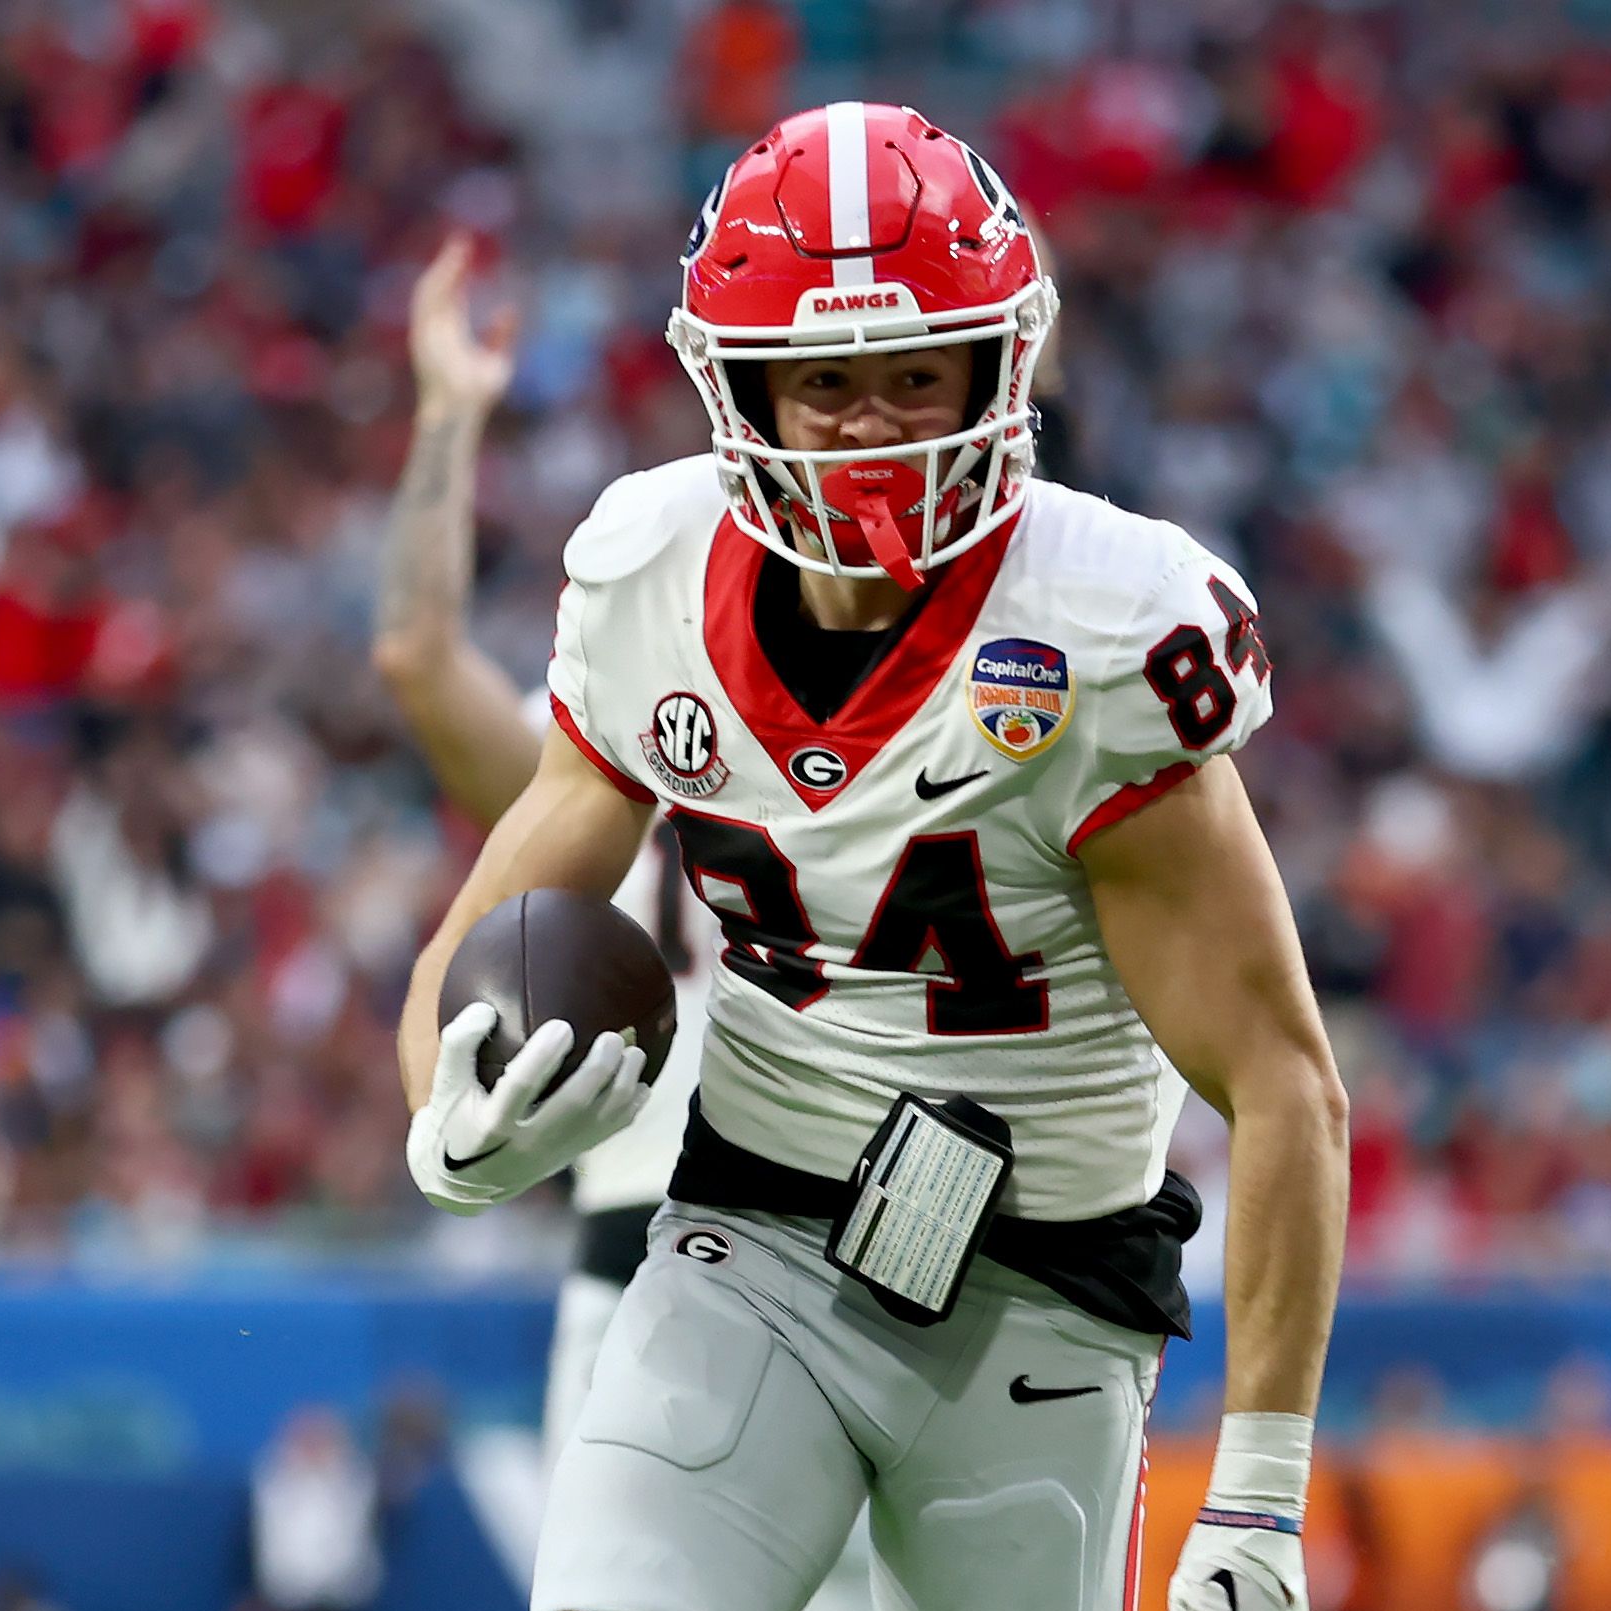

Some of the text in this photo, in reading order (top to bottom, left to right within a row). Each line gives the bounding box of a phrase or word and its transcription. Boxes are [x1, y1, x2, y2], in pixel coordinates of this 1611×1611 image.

[814, 293, 898, 313] DAWGS
[657, 696, 711, 772] SEC
[649, 751, 716, 795] GRADUATE
[789, 747, 847, 790] G
[675, 1231, 731, 1264] G
